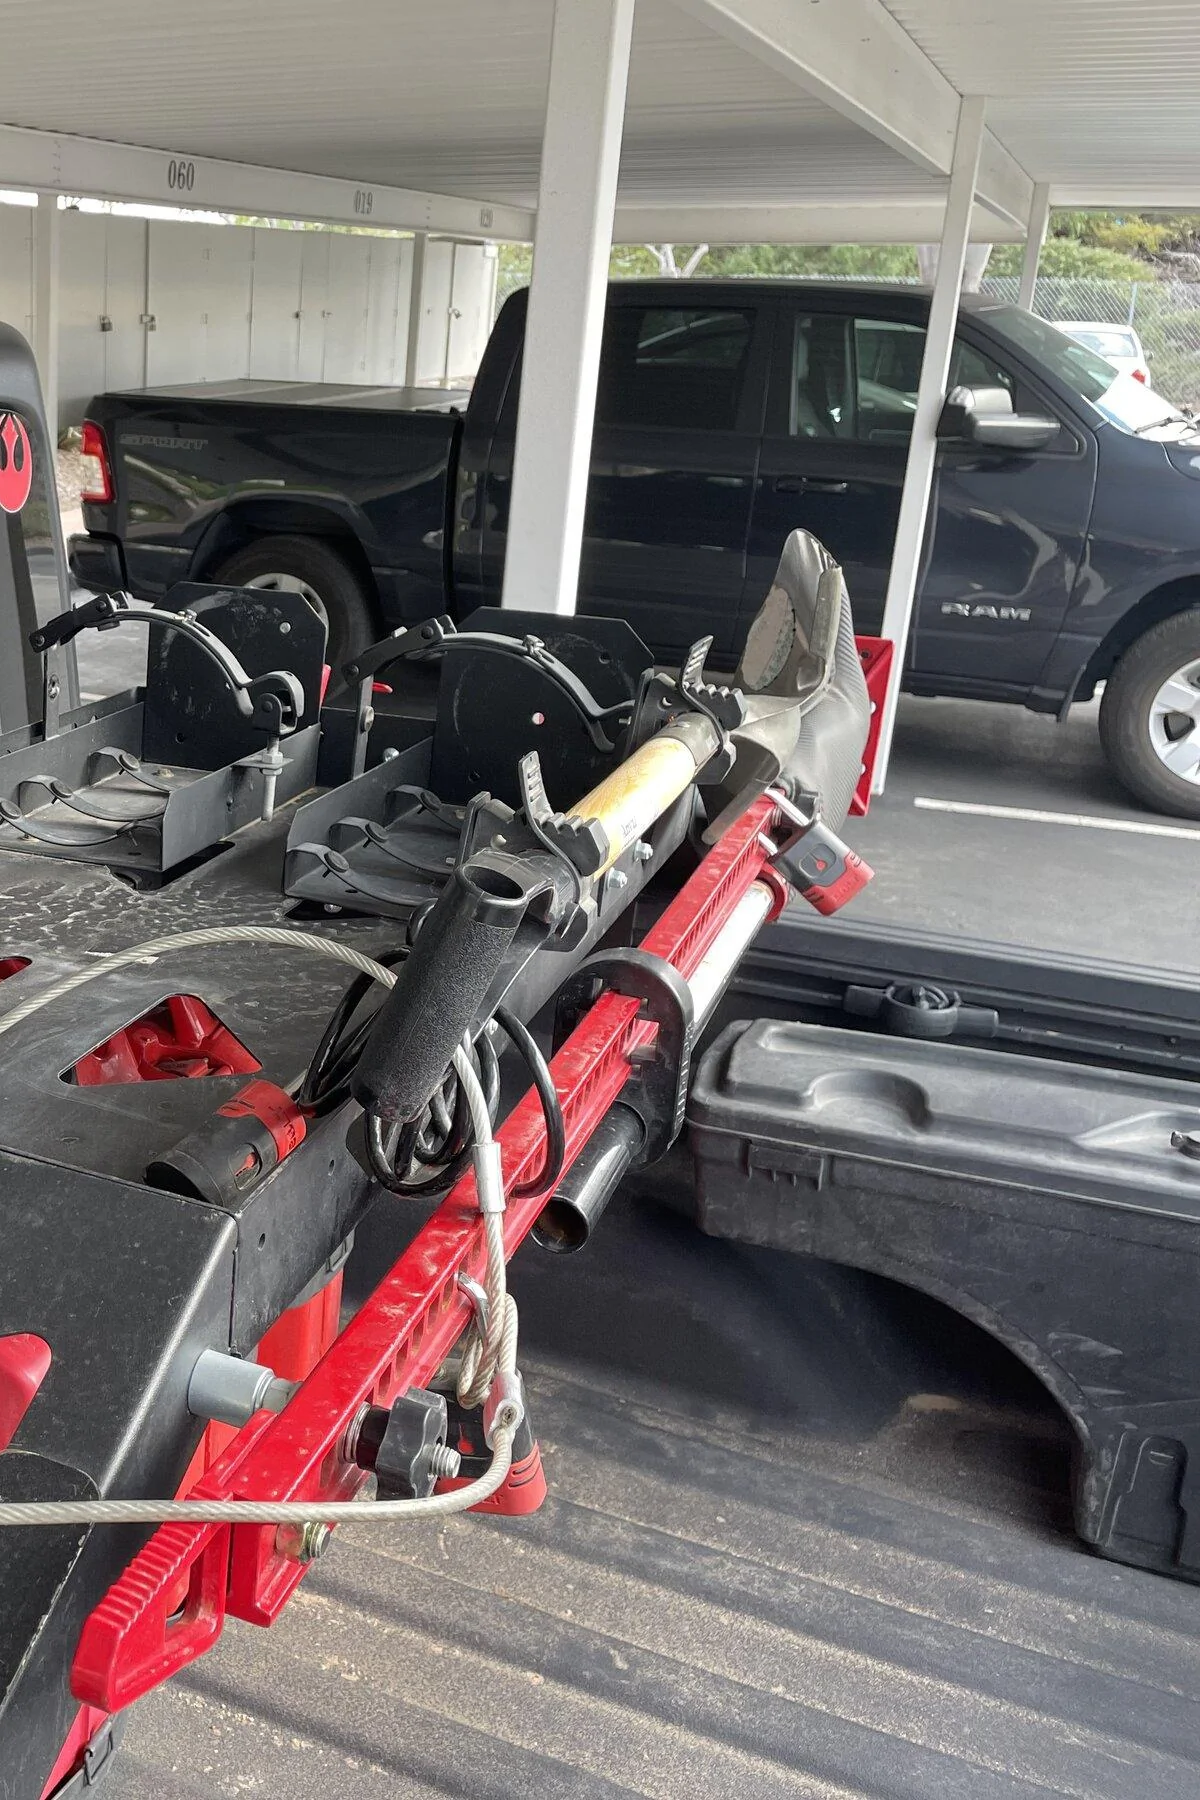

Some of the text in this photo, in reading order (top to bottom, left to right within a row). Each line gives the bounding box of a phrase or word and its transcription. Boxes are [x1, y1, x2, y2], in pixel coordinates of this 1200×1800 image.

[167, 160, 195, 192] 060
[353, 189, 373, 215] 019
[941, 602, 1032, 621] RAM
